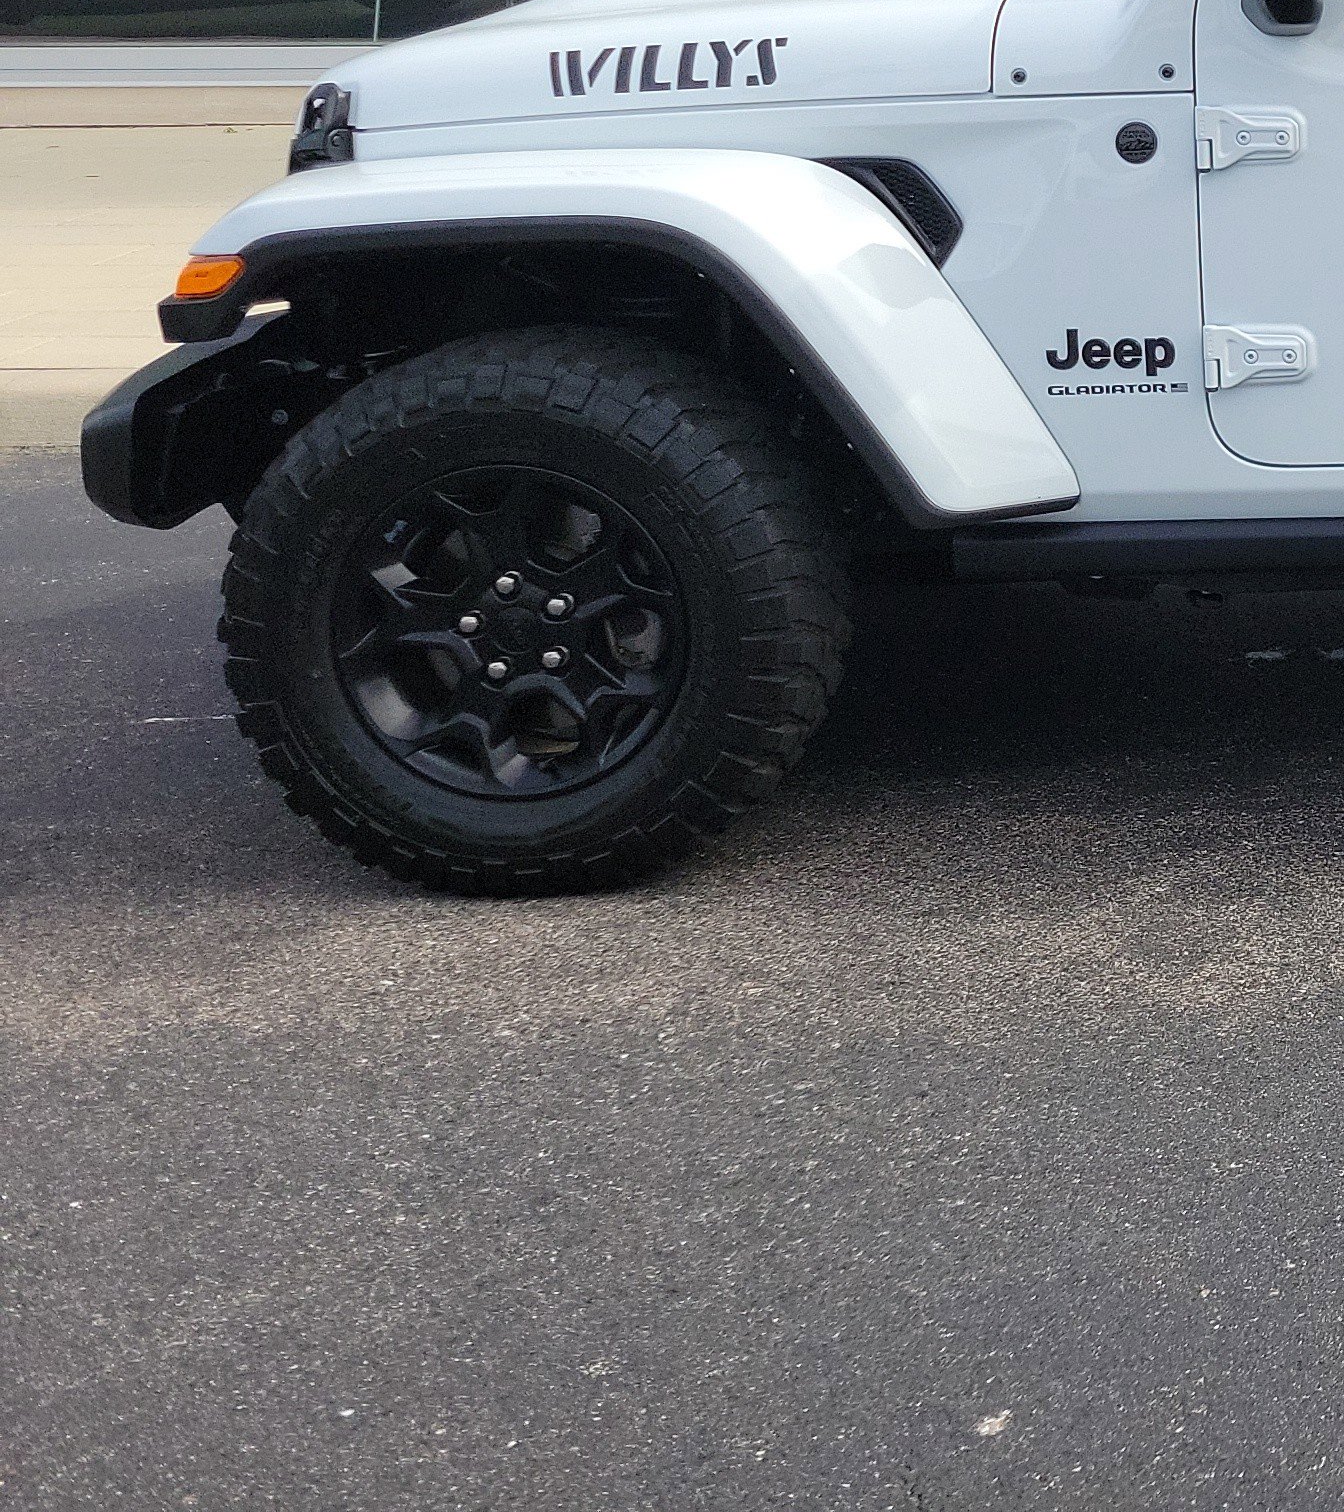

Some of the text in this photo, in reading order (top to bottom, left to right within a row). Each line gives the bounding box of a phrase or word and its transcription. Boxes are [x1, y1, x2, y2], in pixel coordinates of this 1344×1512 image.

[549, 37, 788, 97] WILLYS
[1046, 328, 1175, 376] Jeep
[1047, 383, 1168, 395] GLADIATOR
